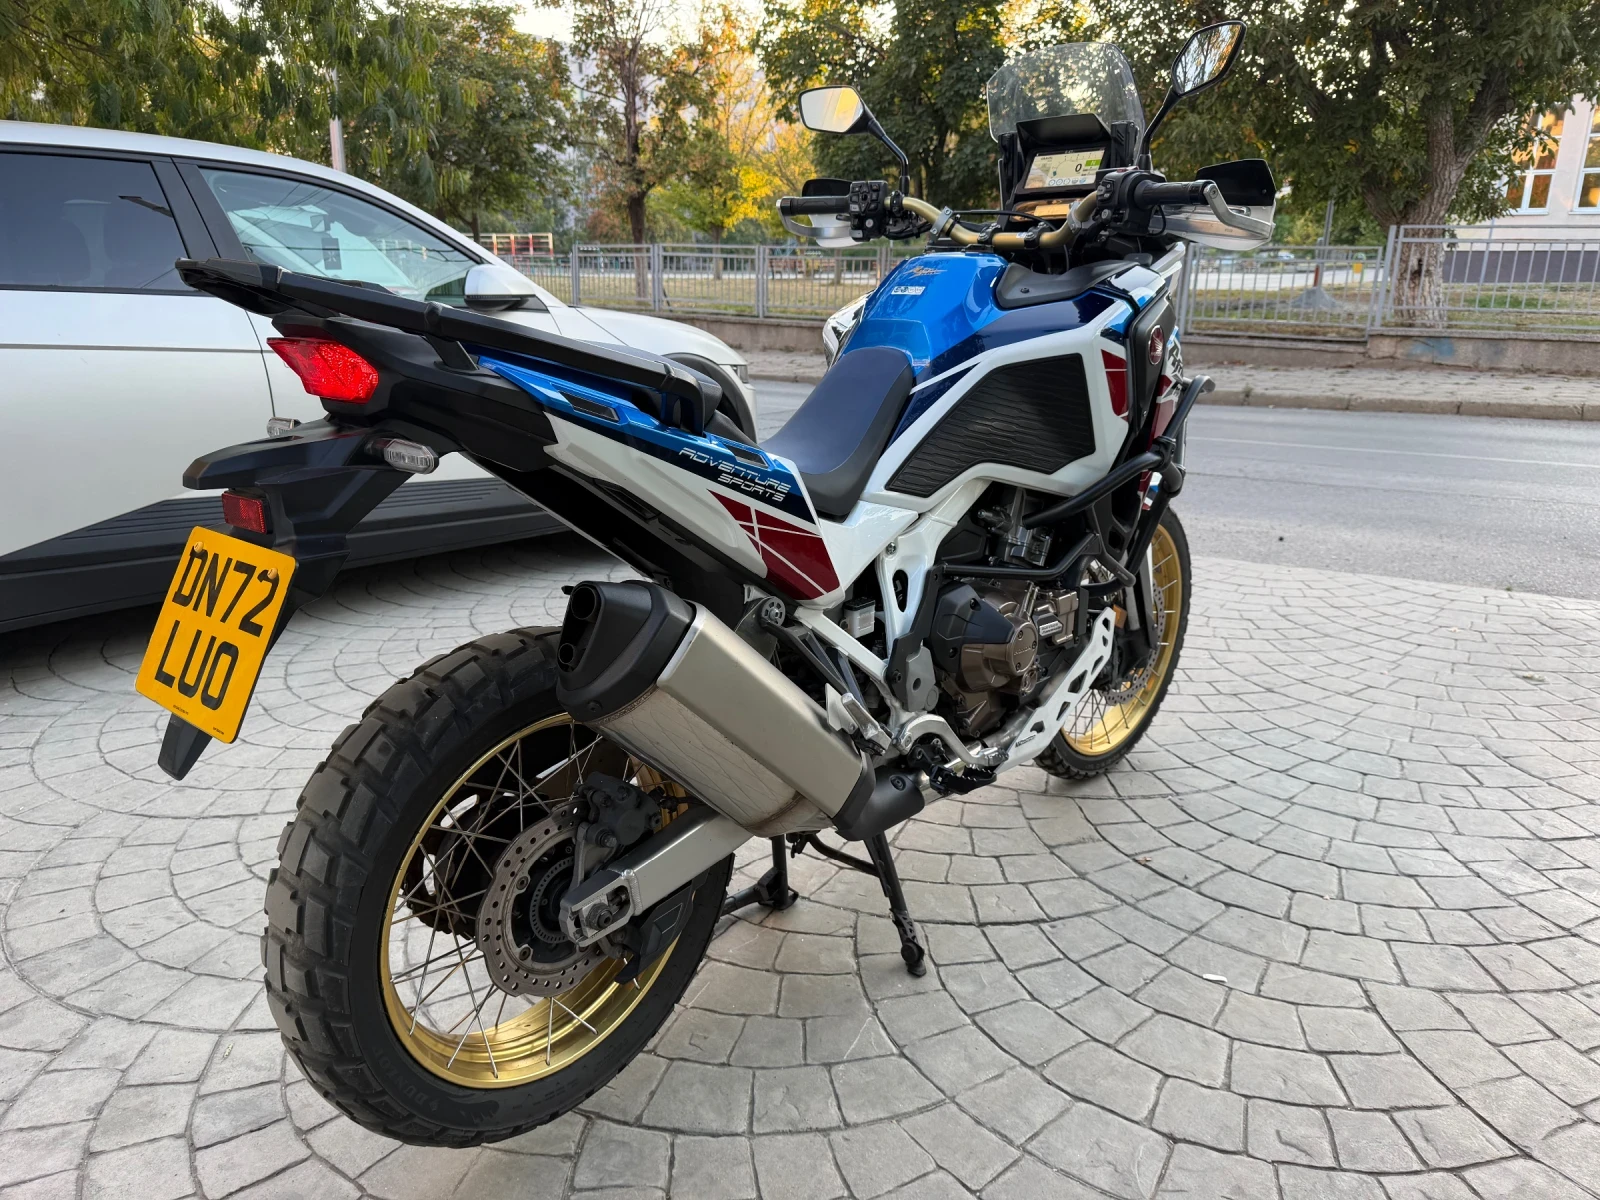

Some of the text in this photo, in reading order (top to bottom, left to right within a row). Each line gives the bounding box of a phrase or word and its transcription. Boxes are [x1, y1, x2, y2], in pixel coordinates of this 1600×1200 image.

[1075, 163, 1082, 172] 0
[678, 447, 792, 494] ADVENTURE
[717, 473, 786, 502] SPORTS
[171, 546, 280, 638] DN72
[154, 619, 240, 711] LUO
